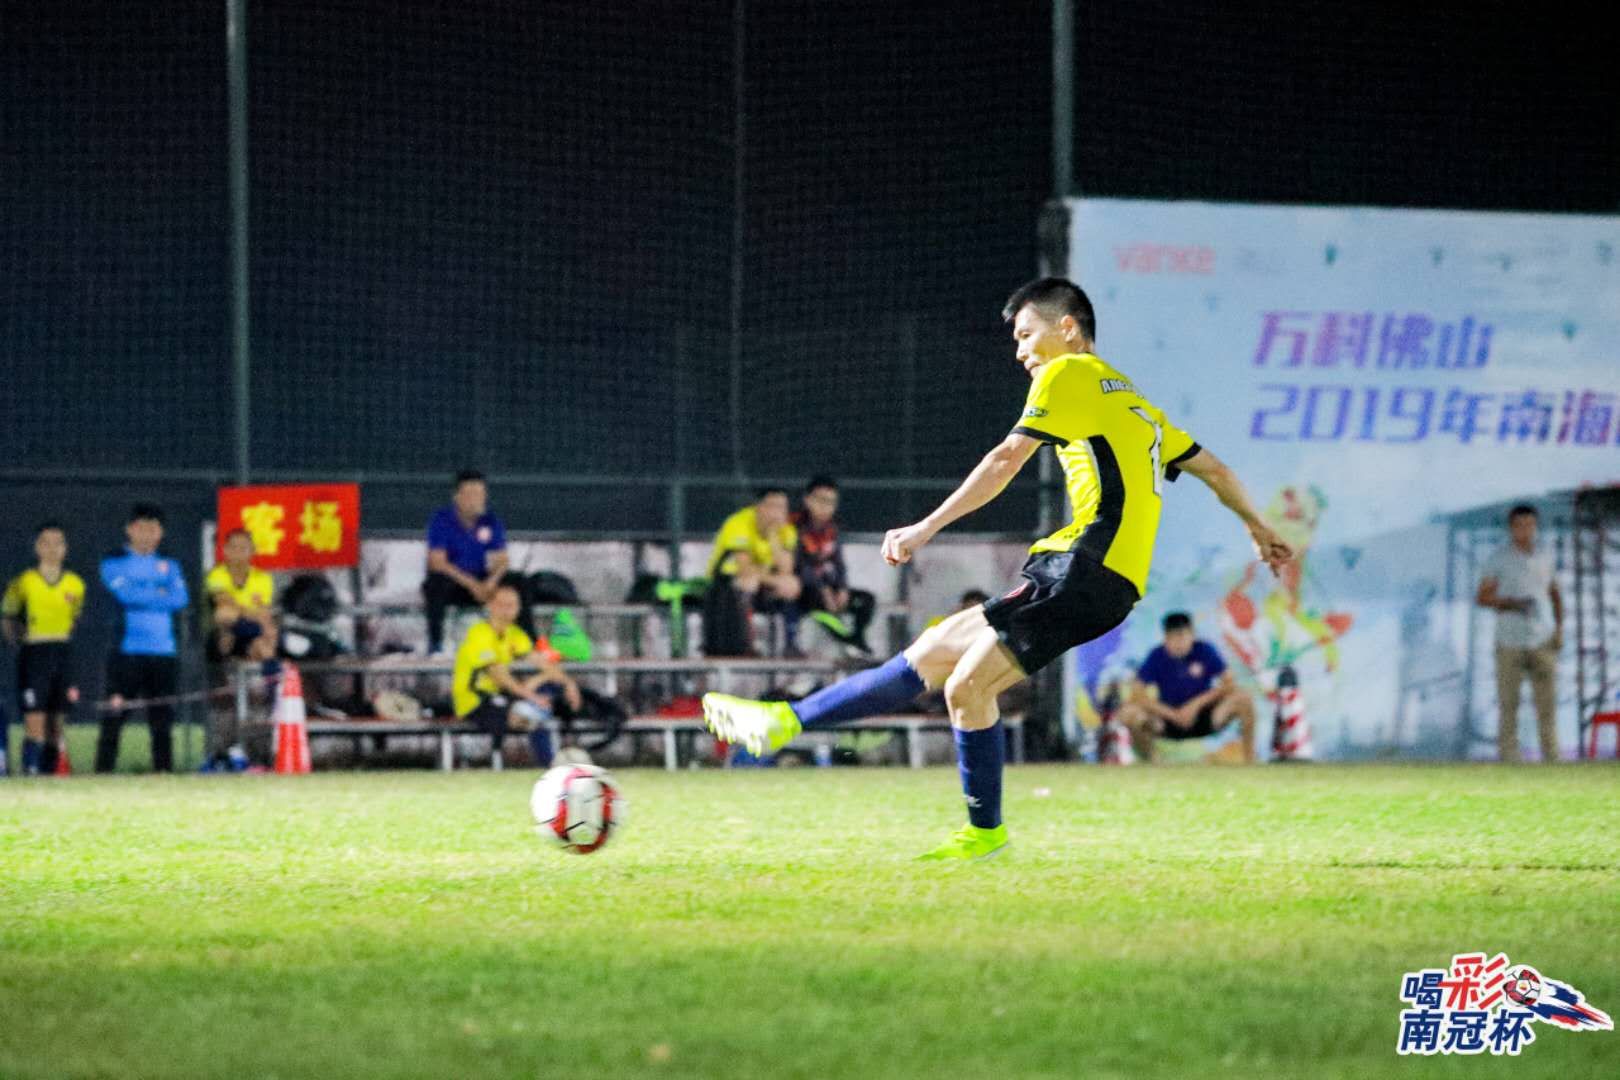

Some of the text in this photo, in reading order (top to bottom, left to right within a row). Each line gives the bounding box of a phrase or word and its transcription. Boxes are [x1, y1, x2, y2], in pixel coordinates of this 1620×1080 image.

[1252, 309, 1495, 370] 万科佛山
[1249, 383, 1620, 446] 2019年南海
